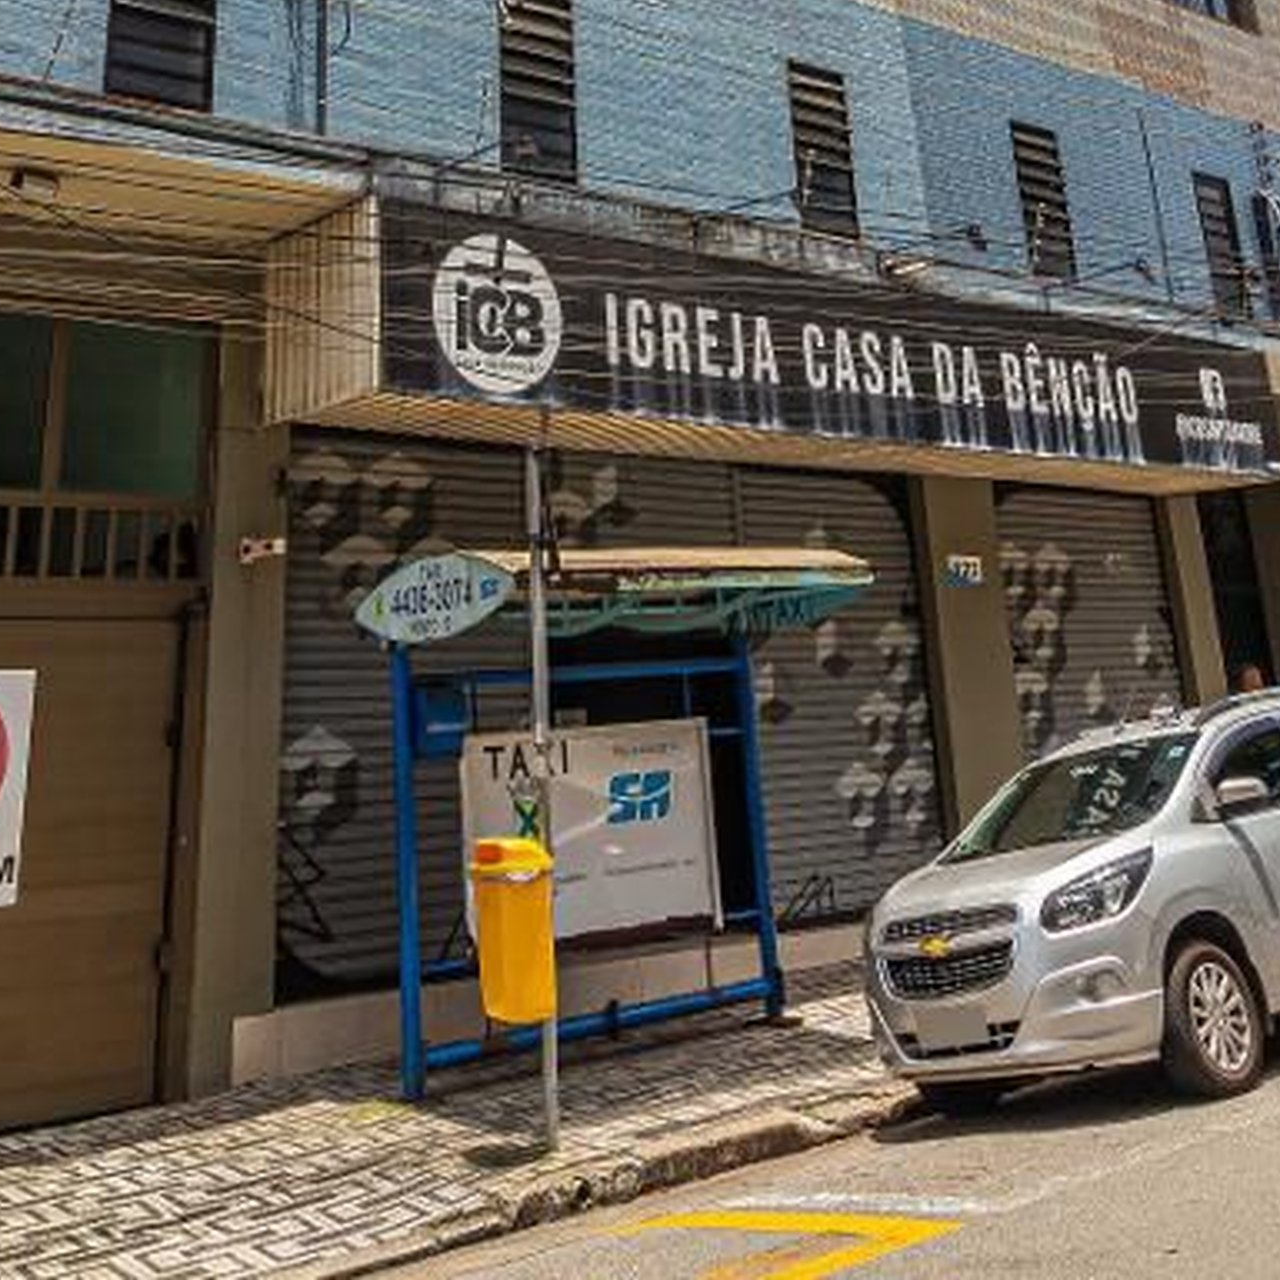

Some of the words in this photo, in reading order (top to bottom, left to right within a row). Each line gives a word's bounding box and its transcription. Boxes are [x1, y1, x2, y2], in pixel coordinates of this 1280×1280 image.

[605, 292, 780, 385] IGREJA
[802, 322, 915, 401] CASA
[931, 341, 986, 408] DA
[999, 342, 1139, 431] BÊNÇÃO
